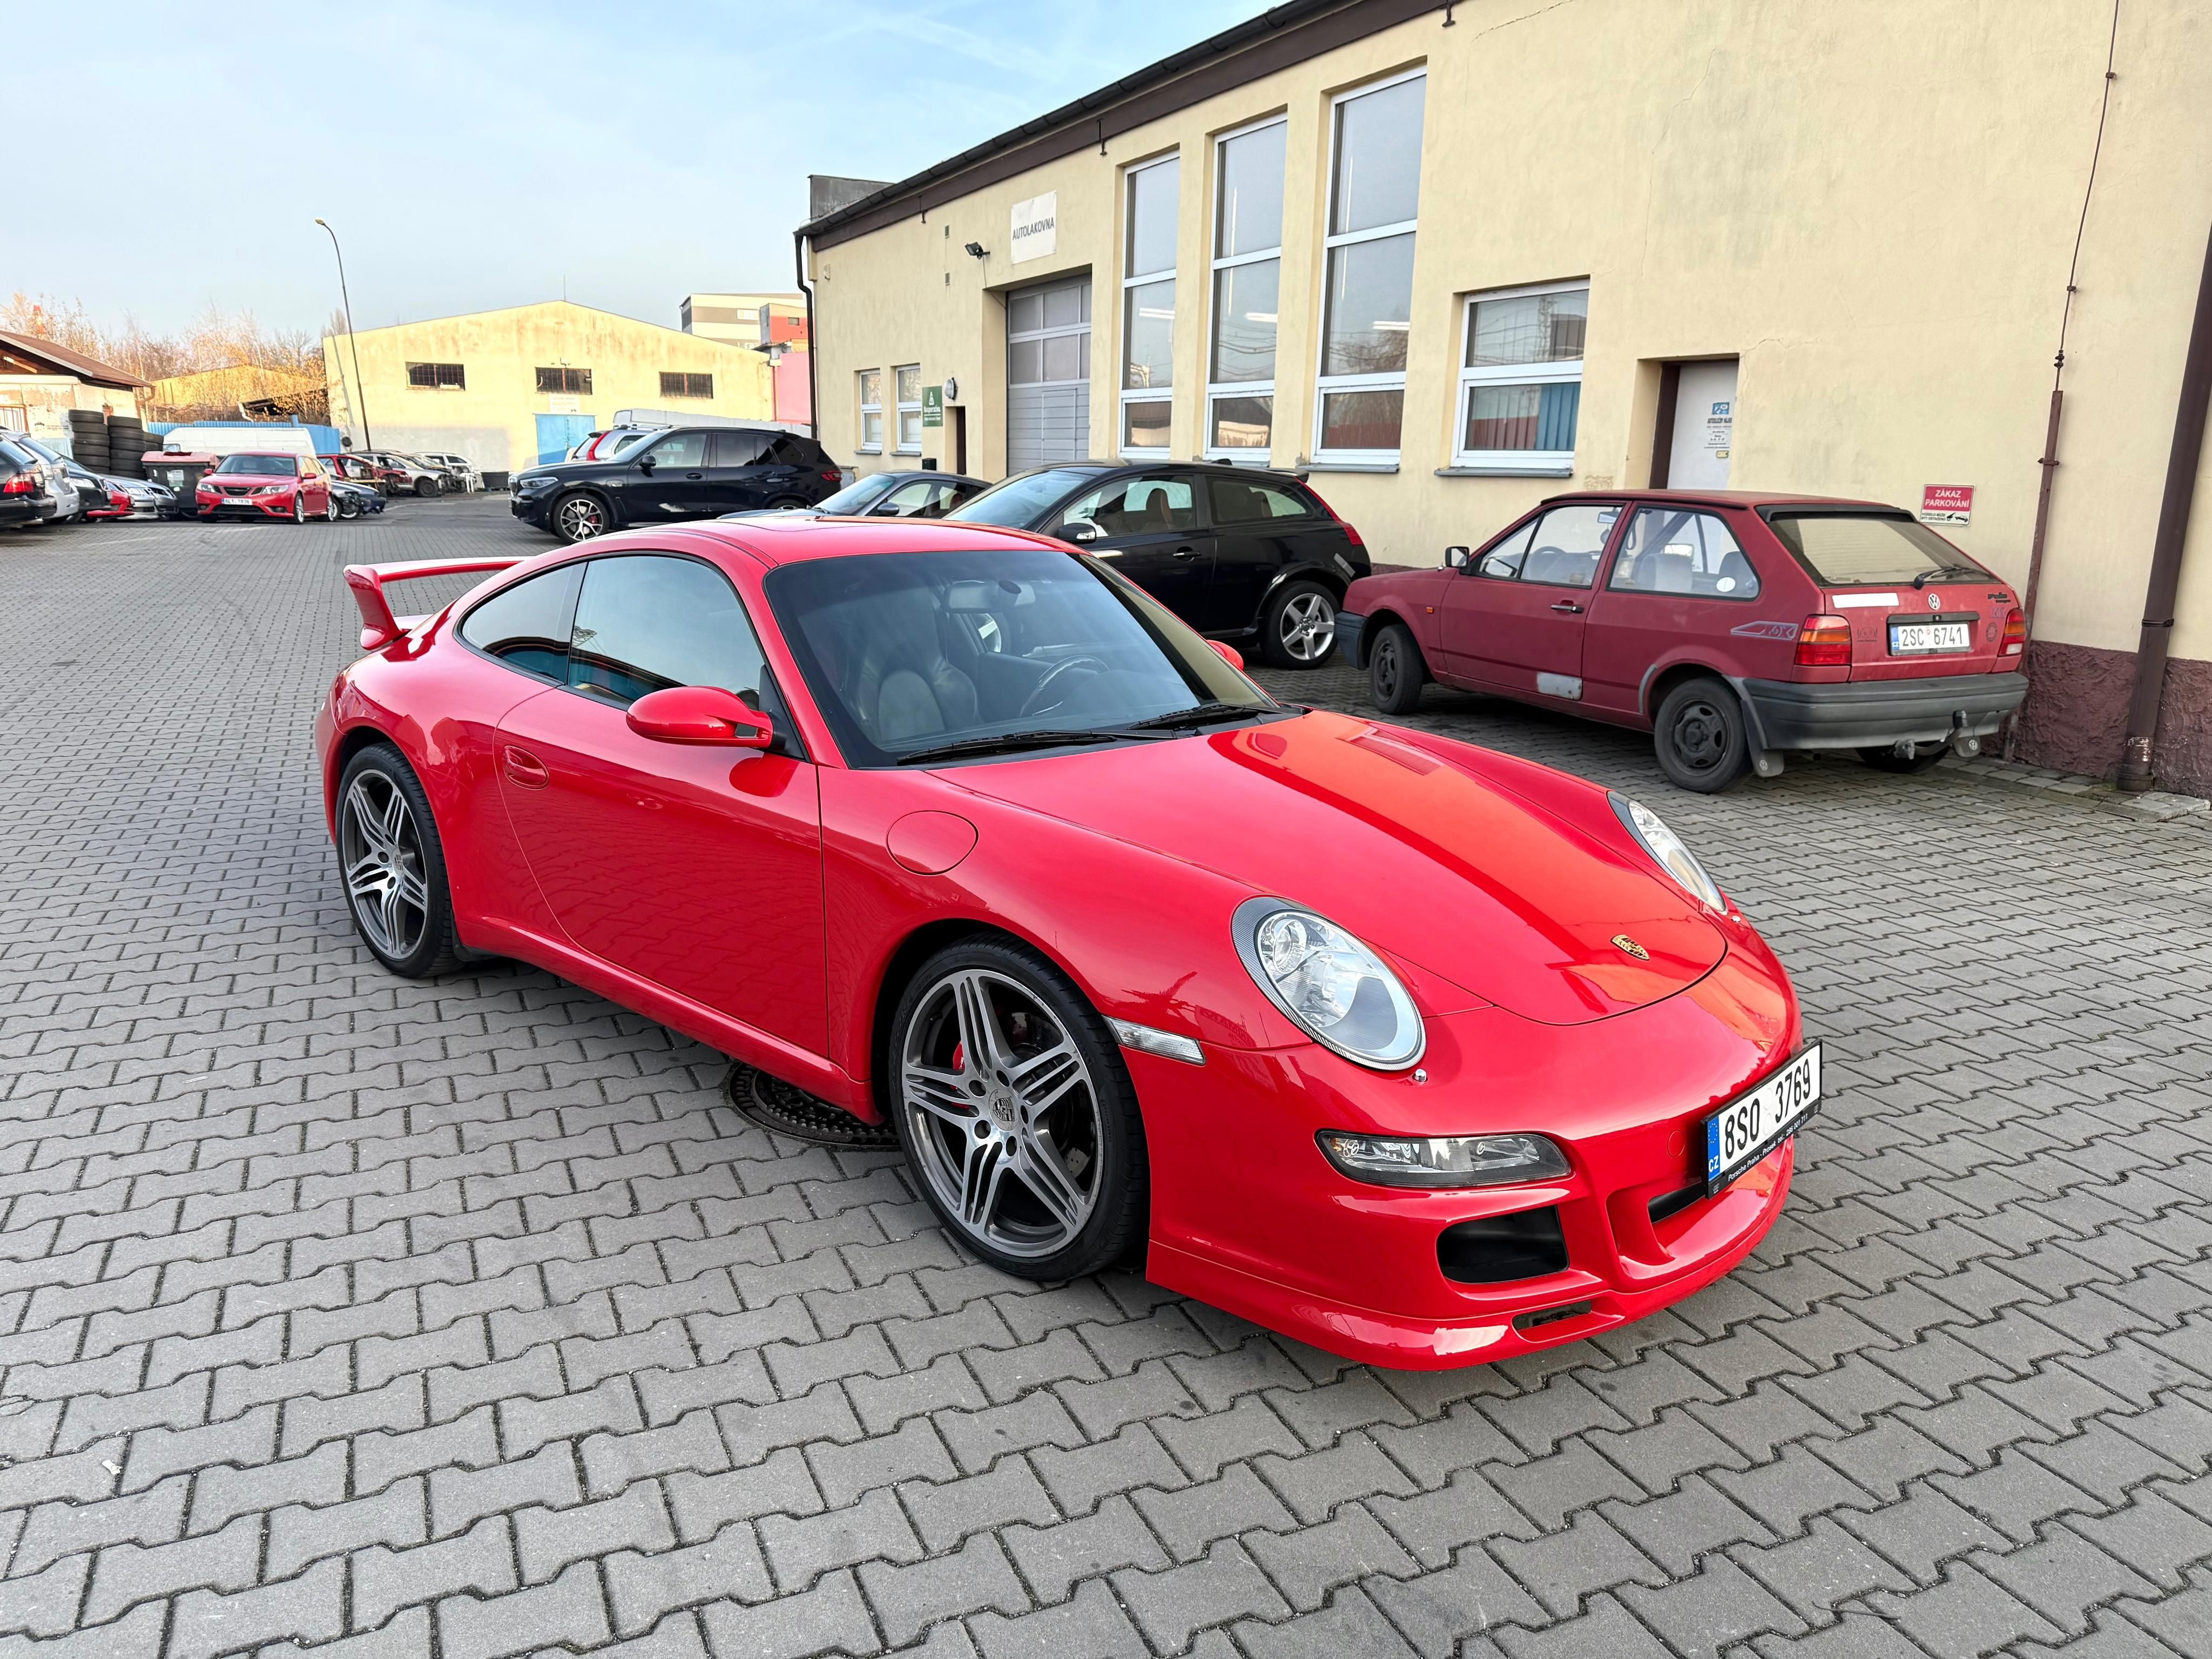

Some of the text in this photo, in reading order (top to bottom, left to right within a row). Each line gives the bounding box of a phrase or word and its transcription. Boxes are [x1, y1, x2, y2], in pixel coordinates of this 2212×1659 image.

[1013, 217, 1054, 240] AUTOLAKOVNA
[1925, 499, 1970, 508] PARKOVÁNÍ
[1936, 489, 1961, 498] ZÁKAZ
[1902, 626, 1963, 646] 2SC 6741
[1775, 1058, 1811, 1123] 3769
[1708, 1155, 1719, 1172] CZ
[1728, 1164, 1746, 1182] Porsche
[1747, 1154, 1759, 1168] Praha
[1762, 1141, 1776, 1156] Prosek
